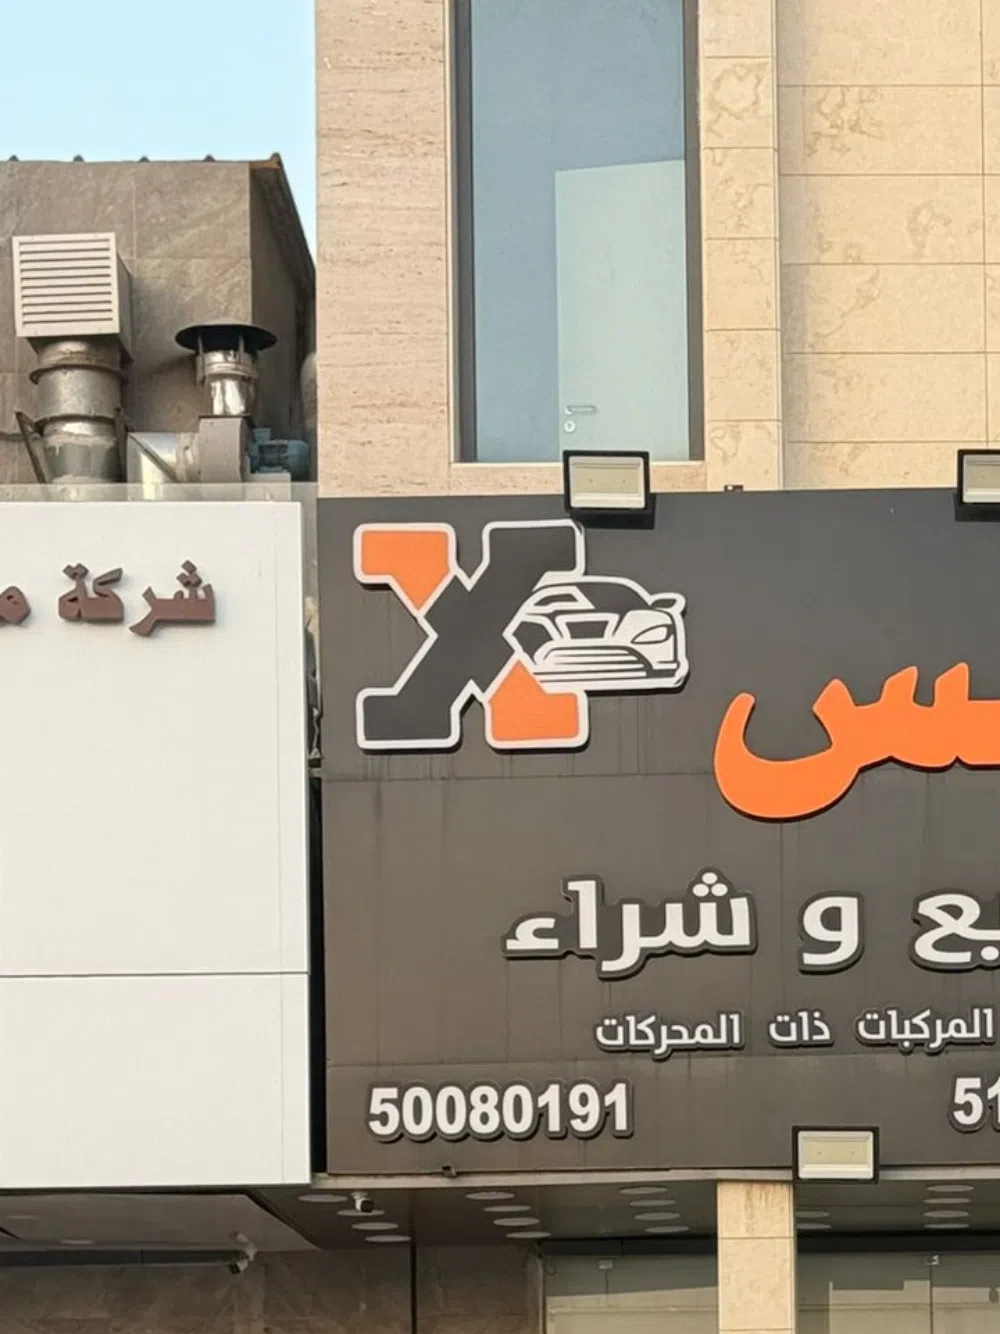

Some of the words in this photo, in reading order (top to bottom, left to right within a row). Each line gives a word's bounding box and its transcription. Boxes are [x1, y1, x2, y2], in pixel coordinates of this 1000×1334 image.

[58, 558, 216, 638] شركة
[506, 871, 752, 973] شراء
[802, 896, 860, 966] و
[595, 1012, 741, 1055] المحركات
[768, 1010, 831, 1042] ذات
[857, 1007, 995, 1050] المركبات
[367, 1082, 628, 1136] 50080191
